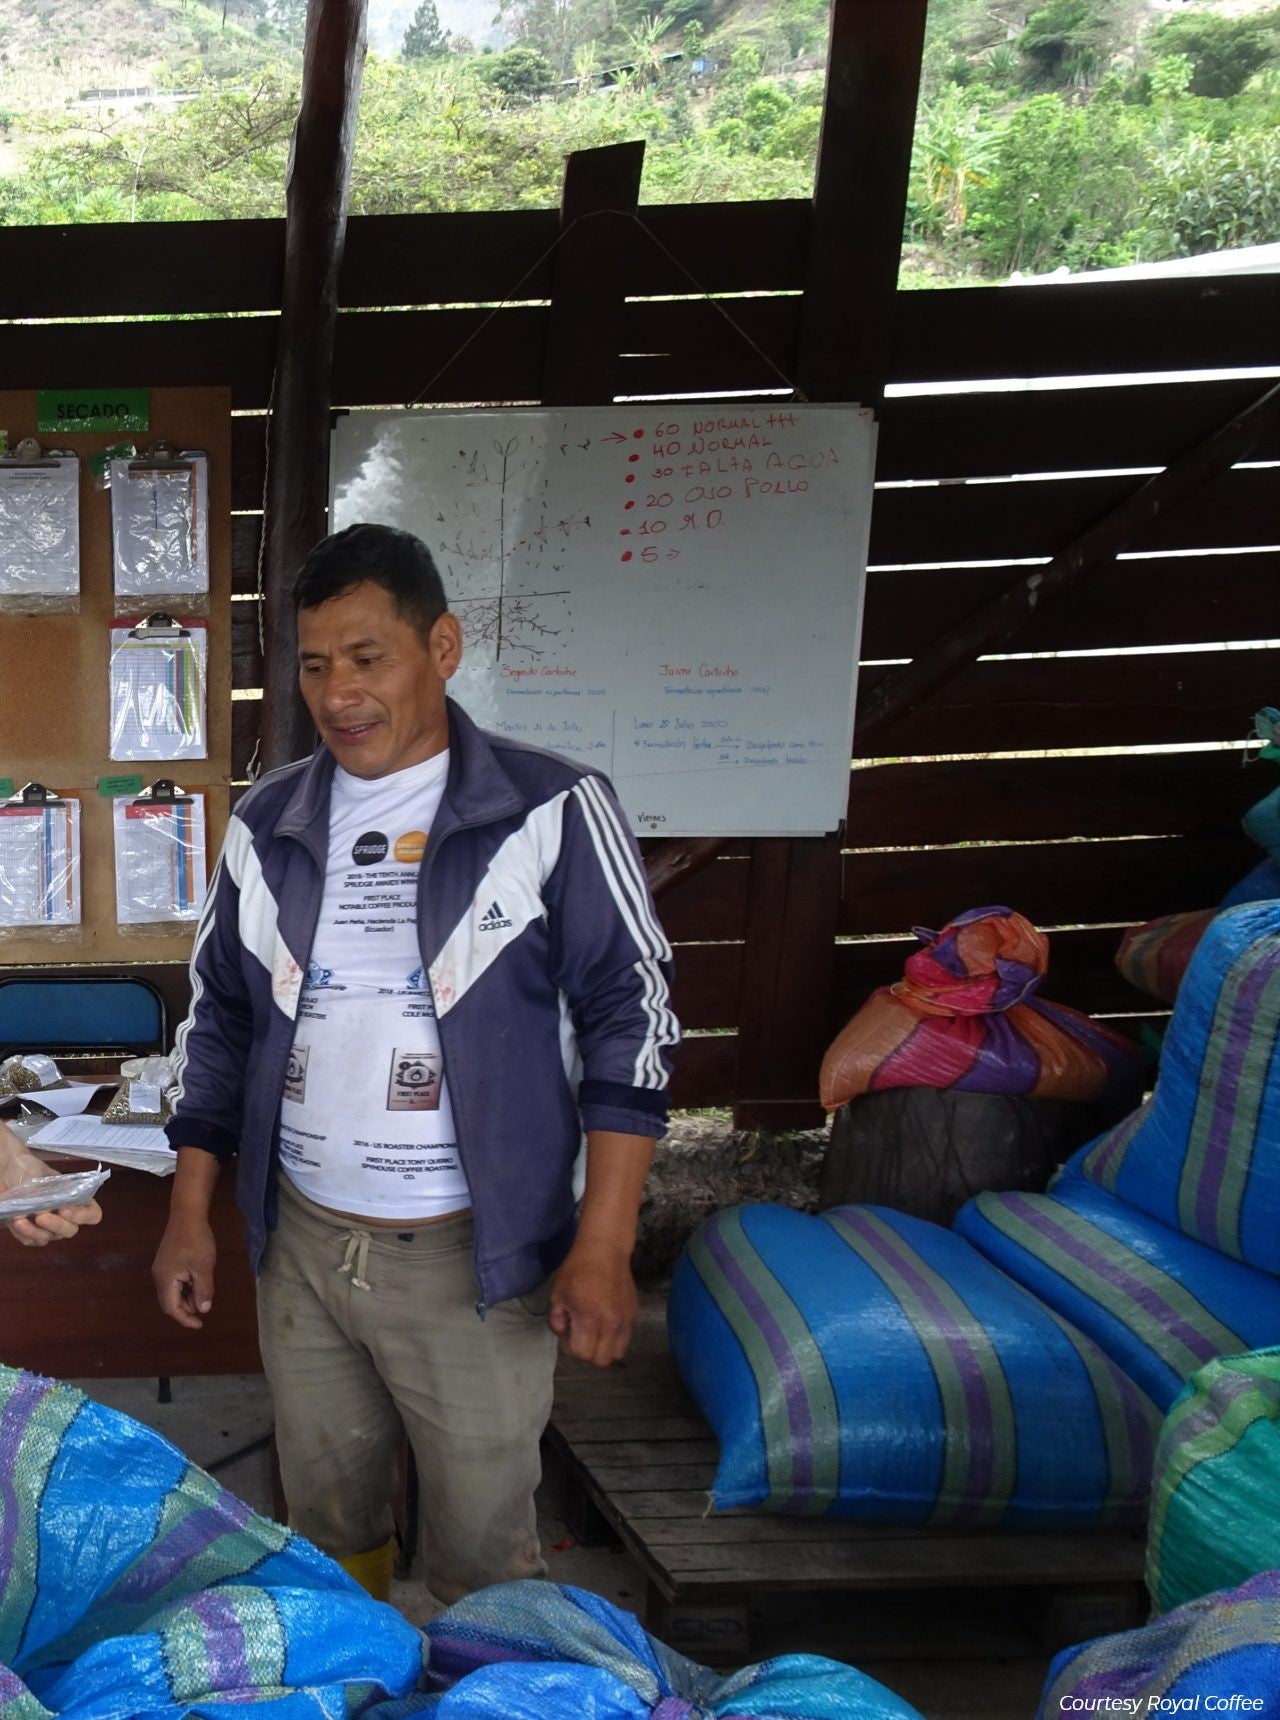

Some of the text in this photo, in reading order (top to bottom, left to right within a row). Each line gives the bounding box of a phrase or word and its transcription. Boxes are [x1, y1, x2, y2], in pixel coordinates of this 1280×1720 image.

[56, 403, 130, 420] SECADO
[655, 422, 680, 438] 60
[692, 417, 761, 436] NORMAL
[652, 434, 772, 457] 40 NORMAL
[651, 467, 674, 479] 30
[646, 493, 674, 508] 20
[639, 520, 667, 535] 10
[640, 546, 659, 563] 5
[636, 811, 667, 823] Viernes
[353, 844, 387, 855] SPRUDGE
[364, 925, 395, 933] (Ecuador)
[478, 919, 513, 931] adidas
[361, 1162, 397, 1172] SPYHOUSE
[425, 1164, 459, 1172] ROASTING
